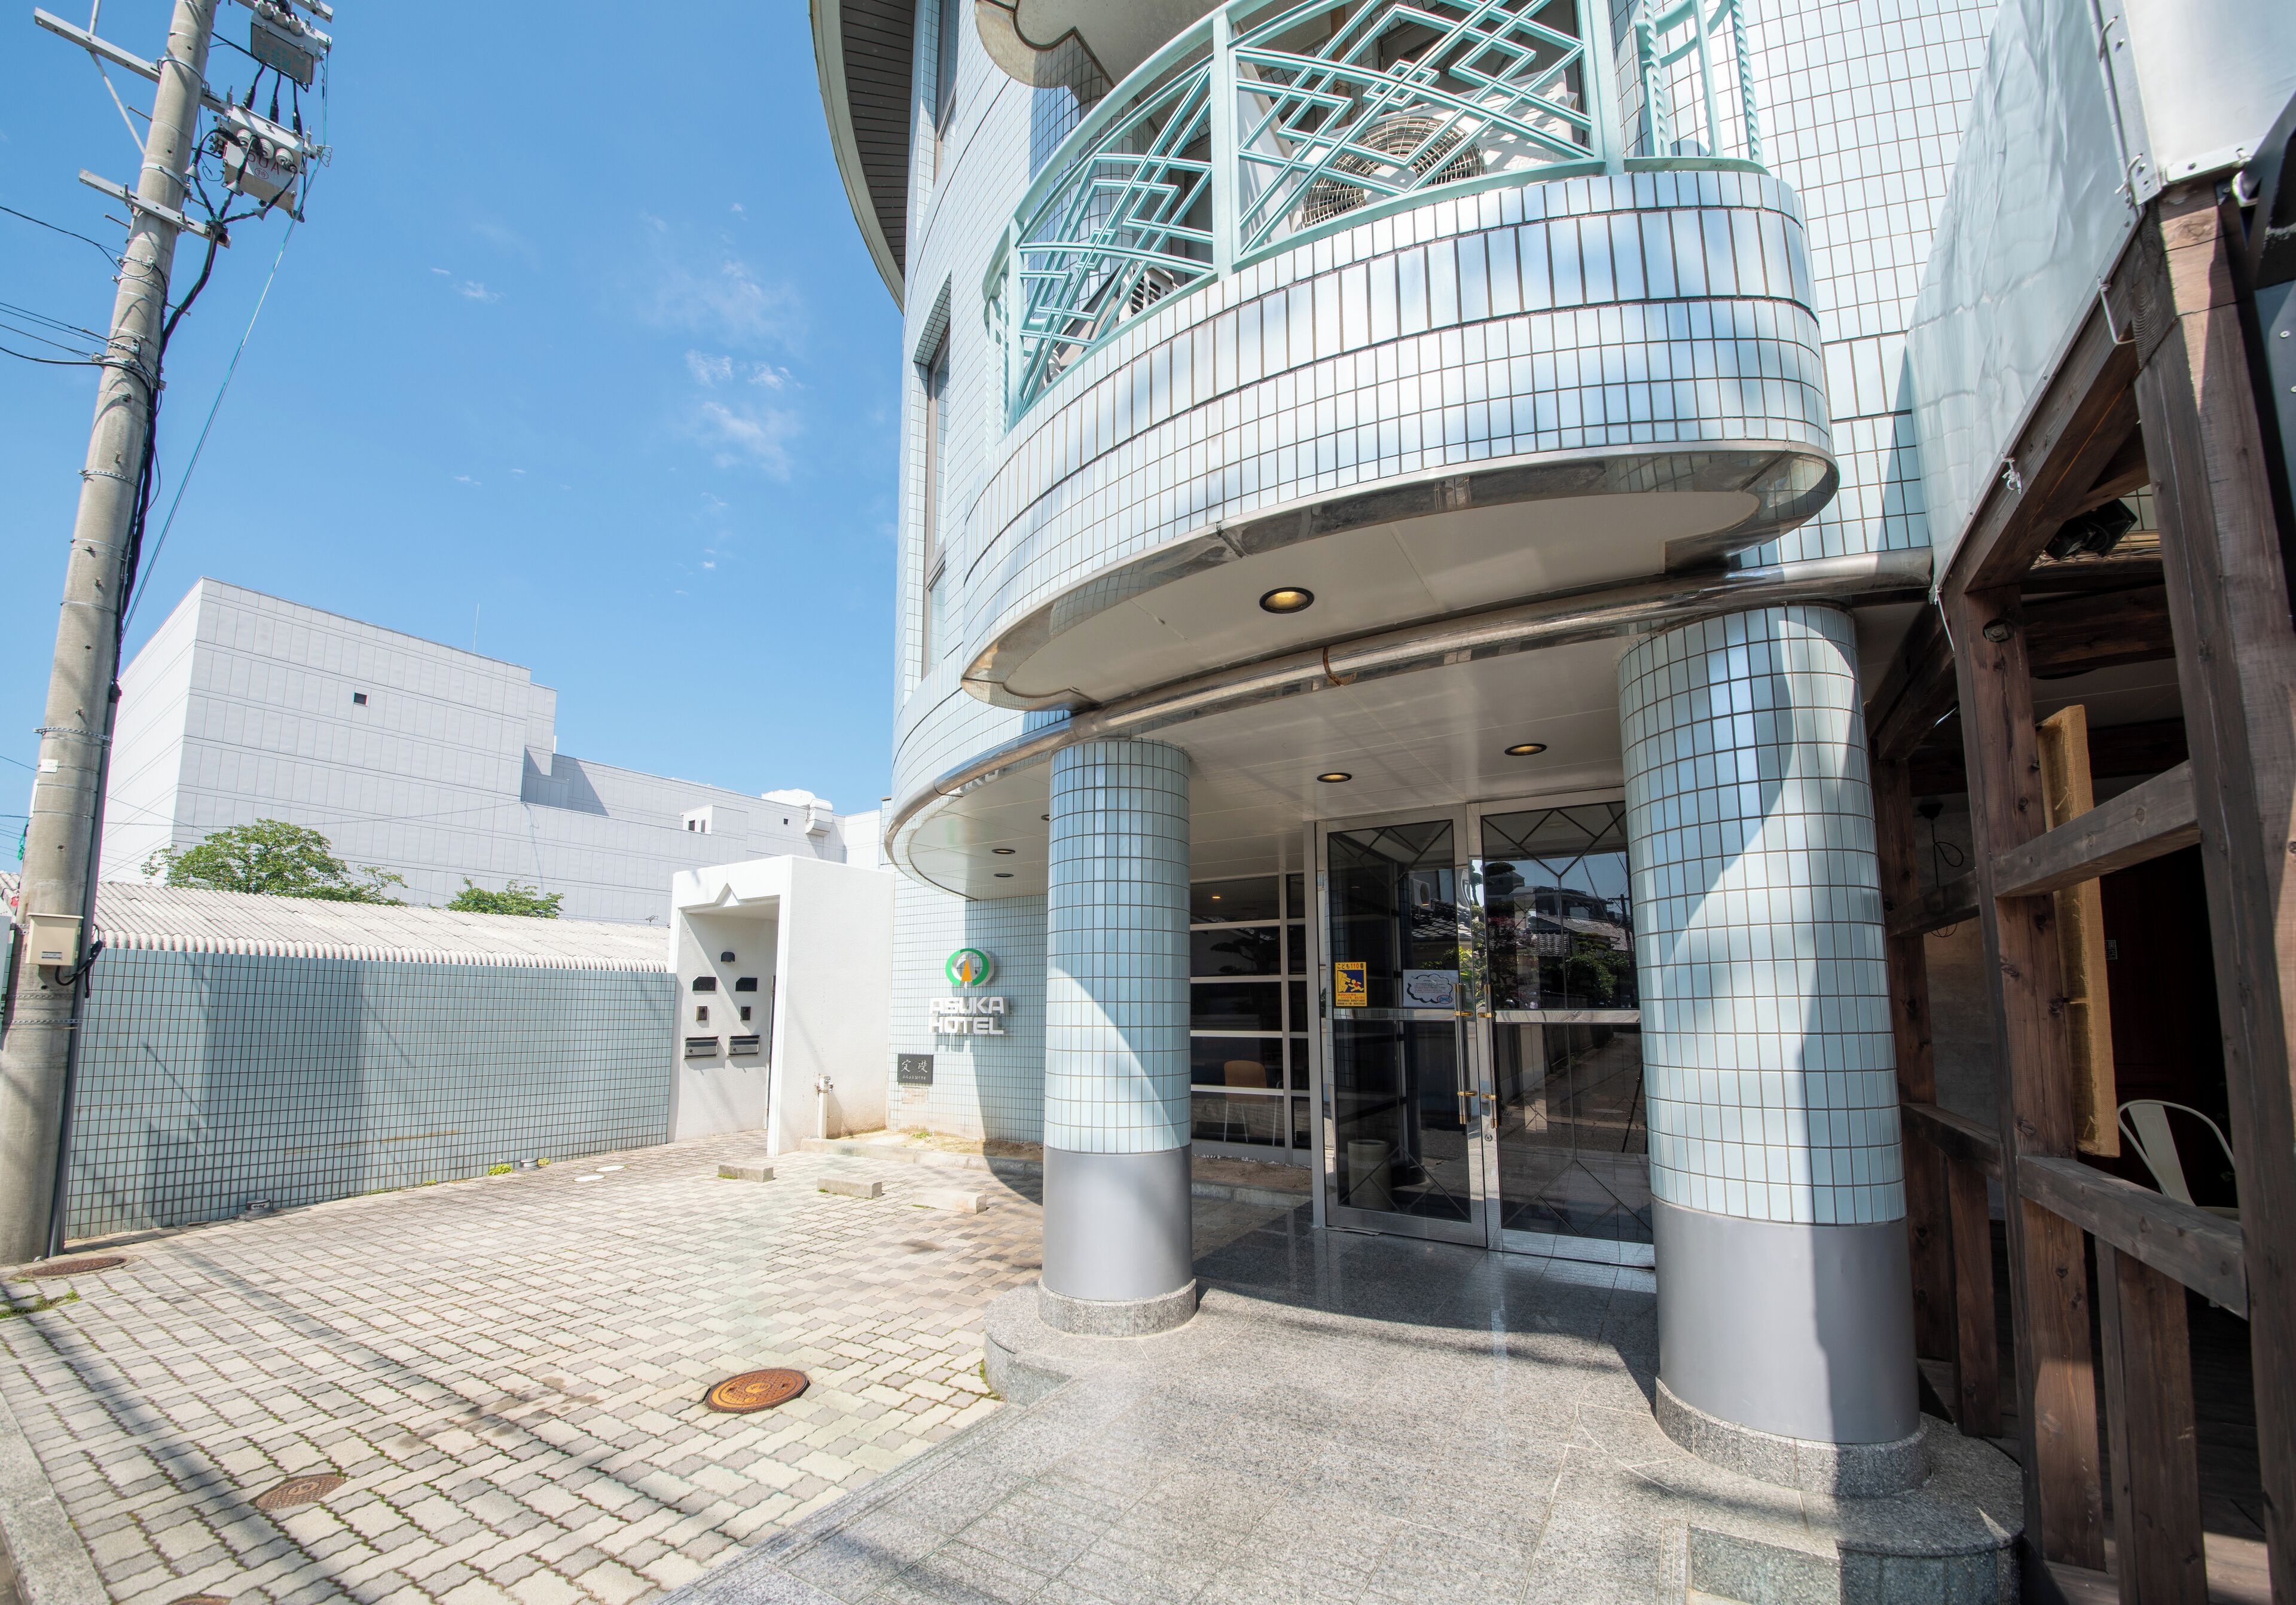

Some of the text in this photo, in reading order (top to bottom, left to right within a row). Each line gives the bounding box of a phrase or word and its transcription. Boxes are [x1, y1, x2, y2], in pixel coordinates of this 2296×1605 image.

[929, 996, 1004, 1014] ASUKA
[928, 1017, 1004, 1035] HOTEL
[900, 1059, 928, 1073] 定礎
